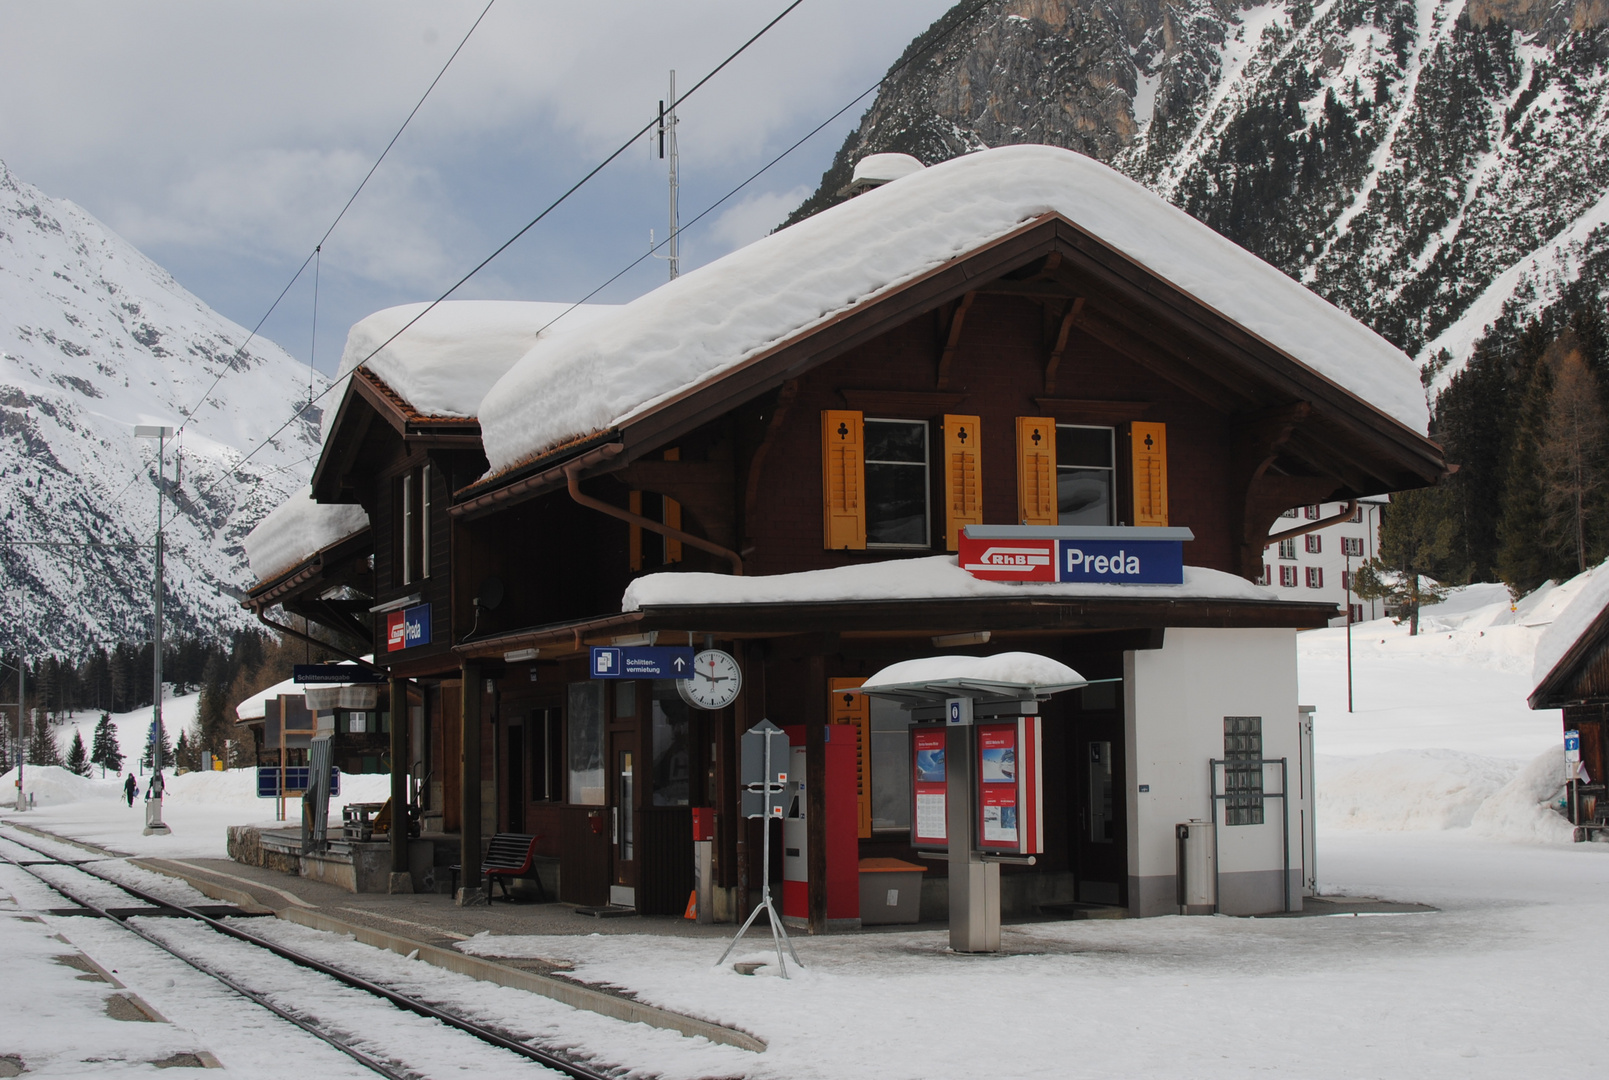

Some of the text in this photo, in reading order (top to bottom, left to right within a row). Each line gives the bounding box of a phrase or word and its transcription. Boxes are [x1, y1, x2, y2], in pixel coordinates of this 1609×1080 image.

[992, 554, 1027, 565] RhB
[1066, 548, 1140, 575] Preda
[405, 619, 421, 641] Preda
[626, 666, 661, 674] vermietung
[297, 674, 350, 682] Schlittenausgabe
